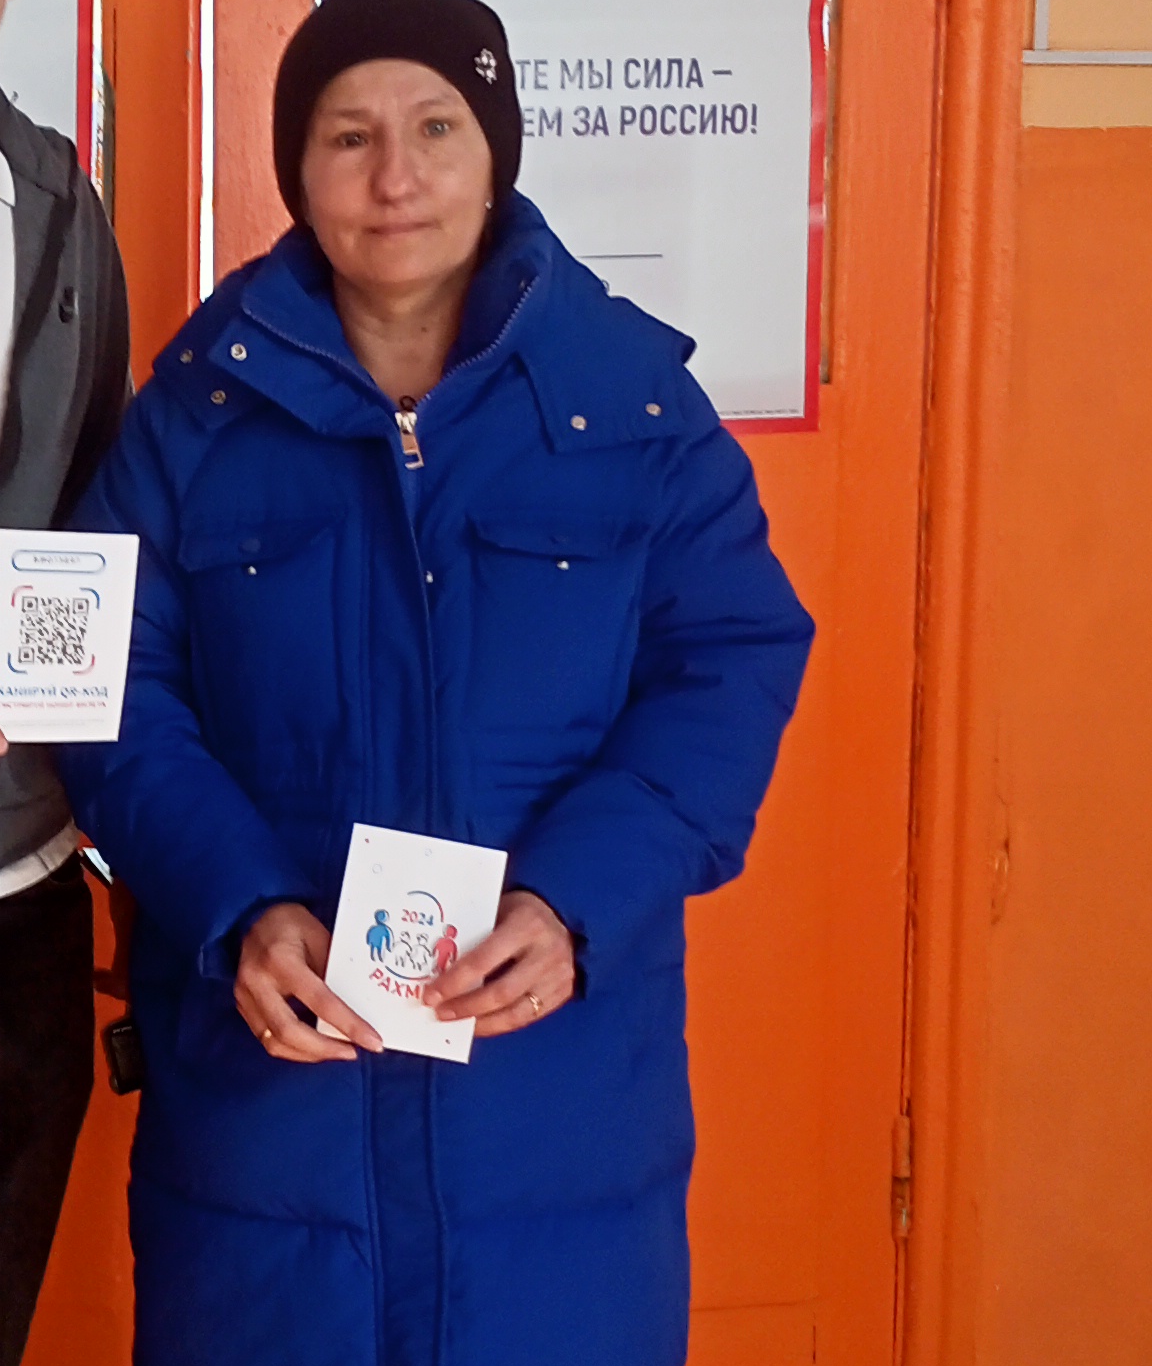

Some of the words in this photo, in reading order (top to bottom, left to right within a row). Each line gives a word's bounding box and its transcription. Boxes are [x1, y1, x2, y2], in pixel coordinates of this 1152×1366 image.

[515, 59, 550, 90] ТЕ
[559, 58, 614, 90] МЫ
[623, 57, 705, 89] СИЛА
[572, 104, 611, 137] ЗА
[619, 102, 759, 136] РОССИЮ!
[401, 908, 435, 927] 2024
[368, 967, 422, 1000] РАХМ
